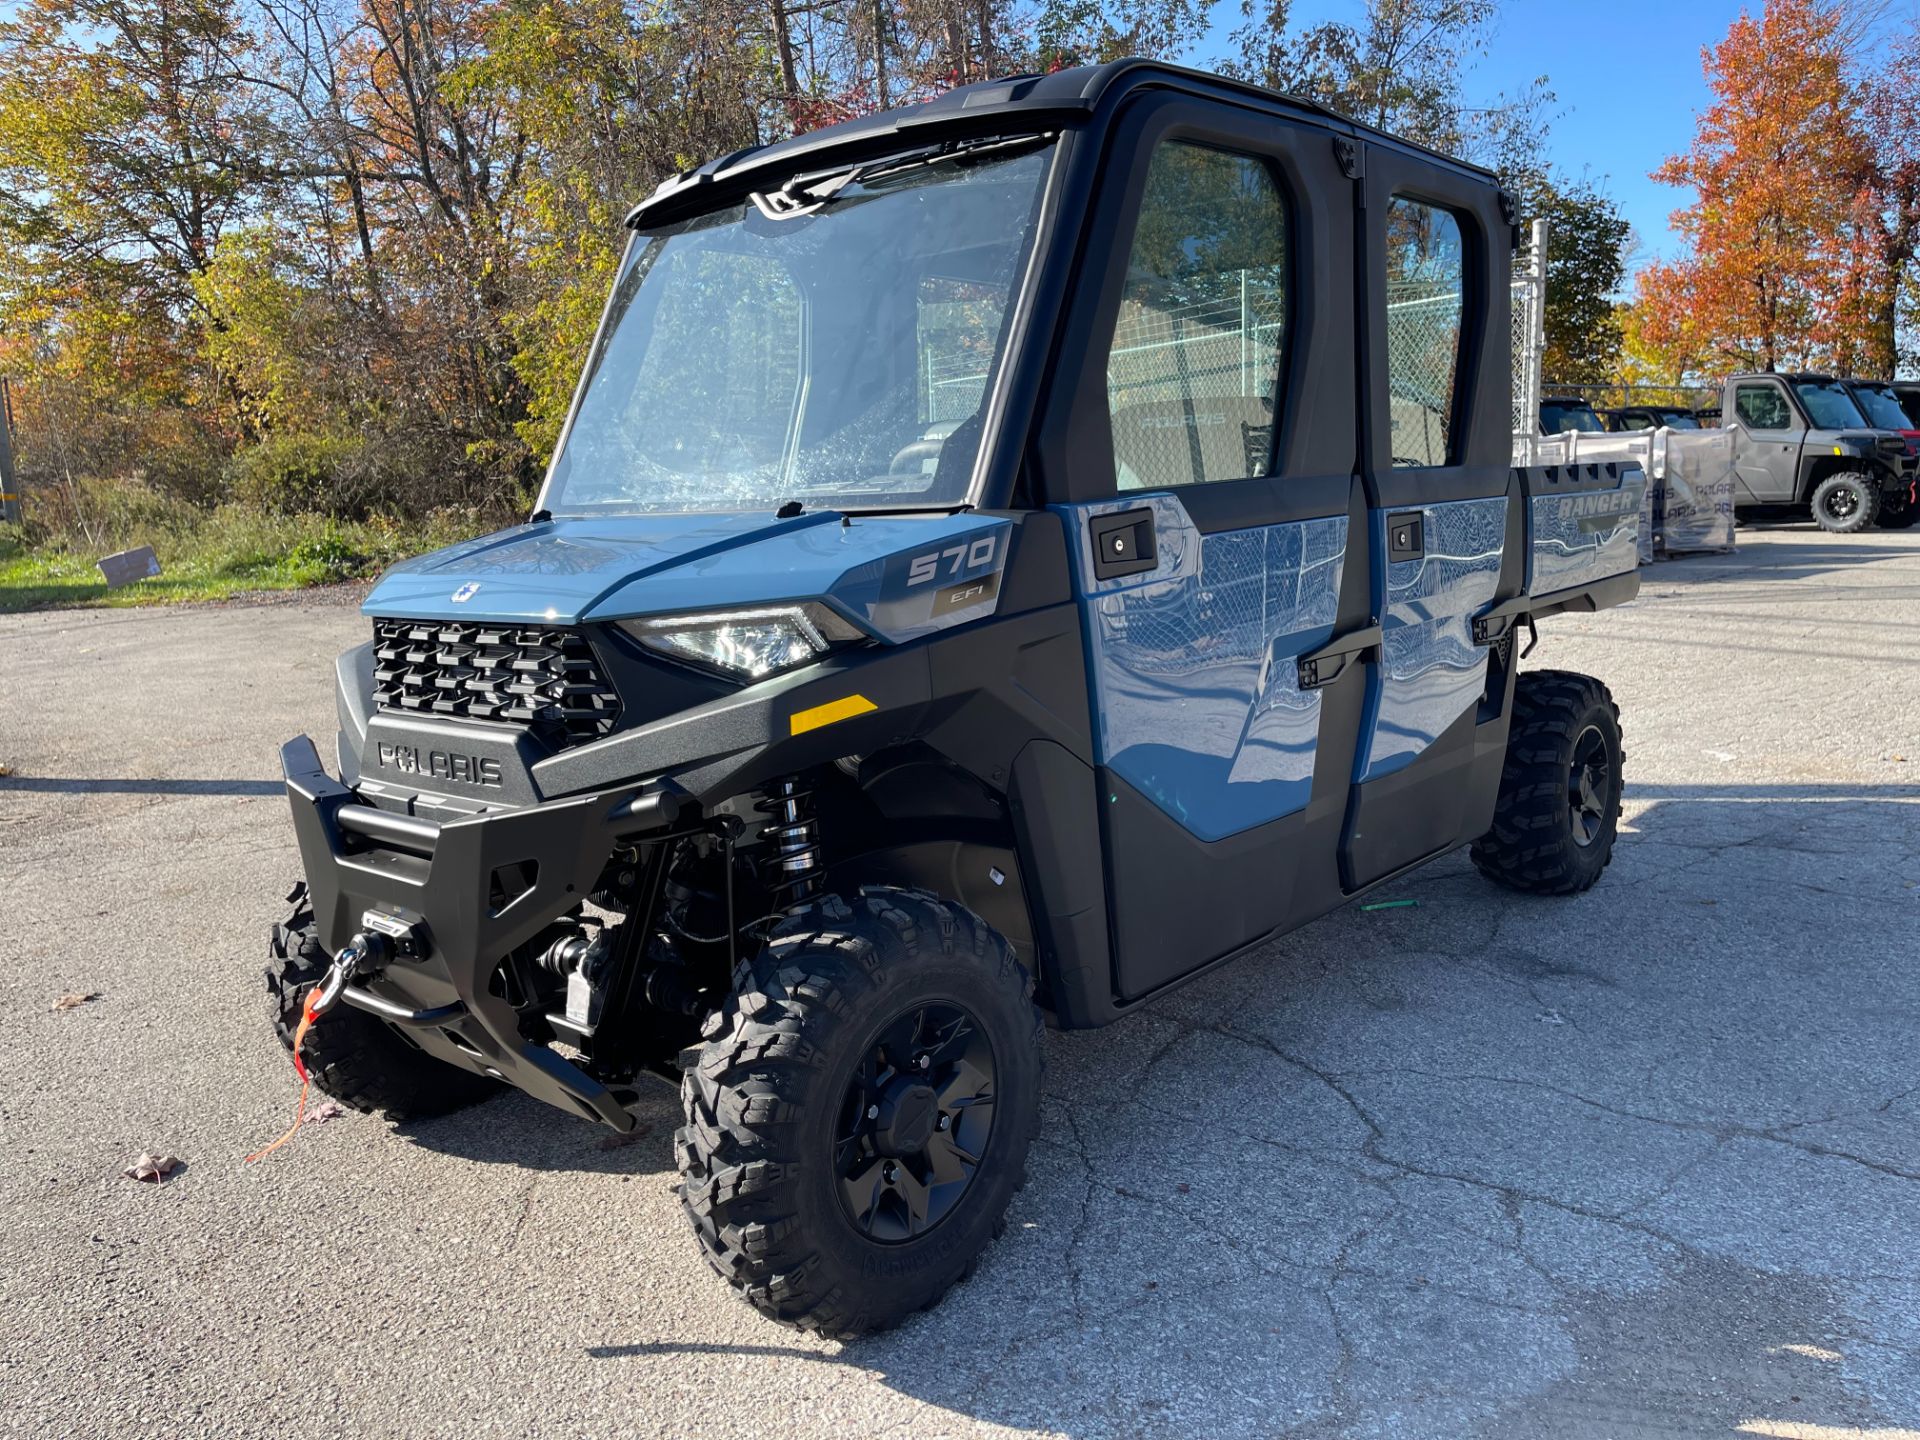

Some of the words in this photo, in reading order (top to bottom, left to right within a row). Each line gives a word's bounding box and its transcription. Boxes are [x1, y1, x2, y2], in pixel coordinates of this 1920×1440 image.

[1558, 491, 1633, 520] RANGER
[907, 536, 996, 587] 570
[950, 585, 984, 604] EFI
[377, 741, 504, 788] POLARIS
